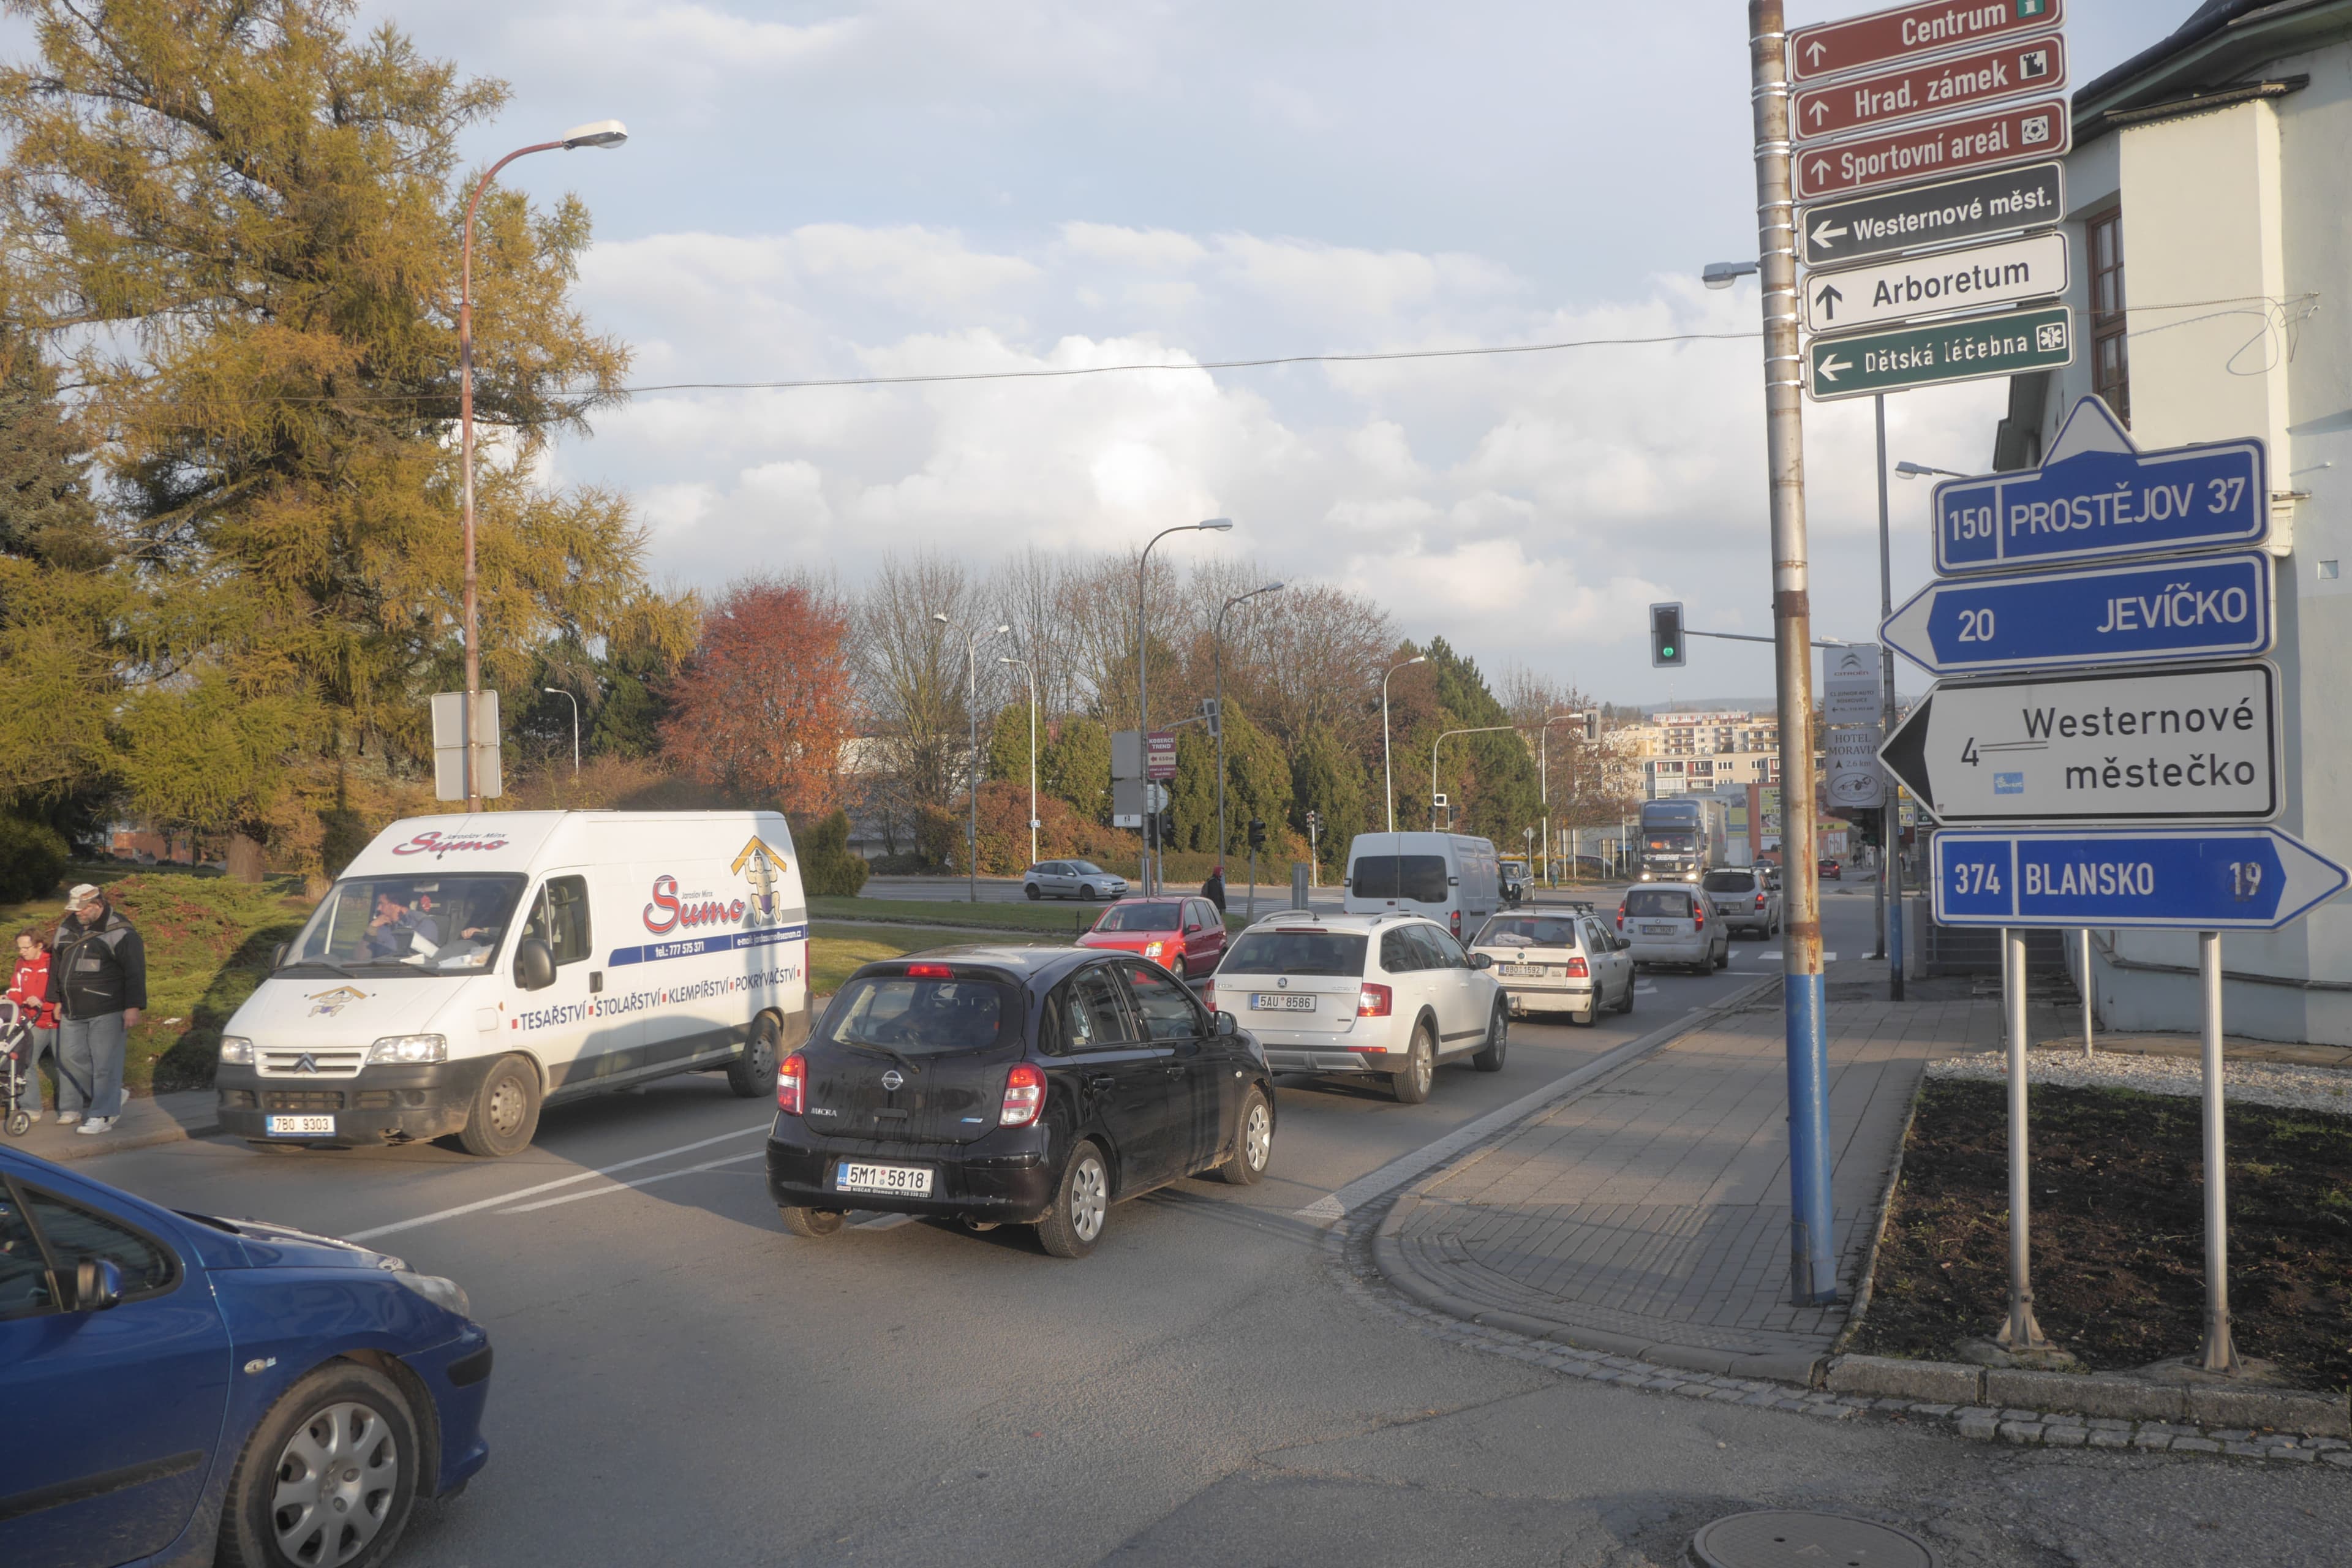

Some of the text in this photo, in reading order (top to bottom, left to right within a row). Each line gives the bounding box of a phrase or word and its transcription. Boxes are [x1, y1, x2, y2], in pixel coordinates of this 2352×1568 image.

[1902, 3, 2007, 46] Centrum
[1855, 59, 2008, 118] Hrad, zámek
[1841, 121, 2009, 184] Sportovní areál
[1853, 186, 2052, 241] Westernové měst.
[1873, 261, 2029, 307] Arboretum
[1866, 334, 2028, 374] Dětská léčebna
[1949, 477, 2246, 541] 150 PROSTĚJOV 37
[1958, 582, 2247, 643] 20 JEVÍČKO
[1835, 734, 1871, 743] HOTEL
[2022, 697, 2254, 739] Westernové
[1829, 745, 1877, 755] MORAVIA
[1960, 737, 2256, 790] 4 městečko
[392, 831, 510, 855] Sumo
[1955, 862, 2262, 896] 374 BLANSKO 19
[643, 875, 745, 935] Sumo
[656, 941, 704, 957] tel.: 777 575 371
[521, 965, 796, 1031] TESAŘSTVÍ STOLAŘSTVÍ KLEMPÍŘSTVÍ POKRÝVAČSTVÍ
[1261, 997, 1311, 1008] 5AU 8586
[303, 1118, 328, 1130] 9303
[810, 1107, 837, 1117] MICRA
[850, 1167, 924, 1188] 5M1 5818
